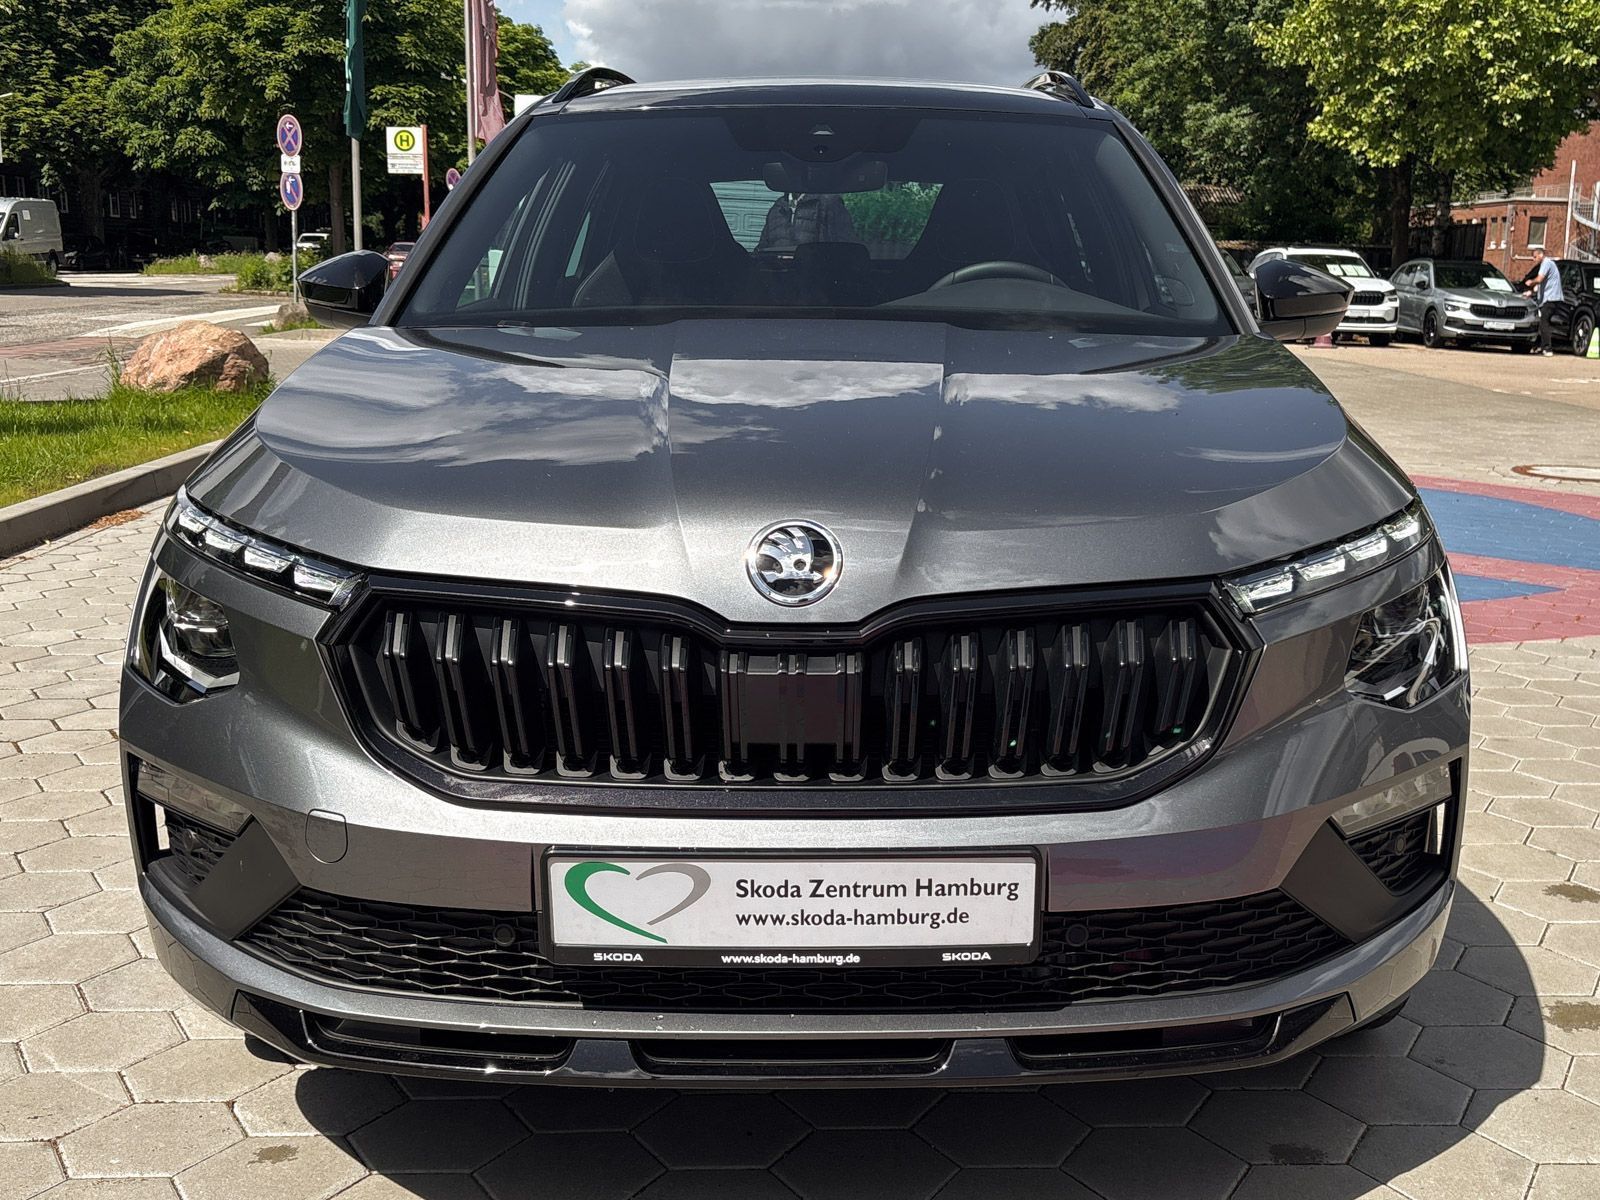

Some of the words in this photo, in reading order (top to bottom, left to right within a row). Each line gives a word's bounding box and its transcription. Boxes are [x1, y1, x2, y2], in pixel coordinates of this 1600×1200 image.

[735, 879, 802, 898] Skoda
[808, 878, 907, 898] Zentrum
[915, 877, 1020, 901] Hamburg
[735, 907, 970, 929] www.skoda-hamburg.de
[720, 953, 861, 966] www.skoda-hamburg.de
